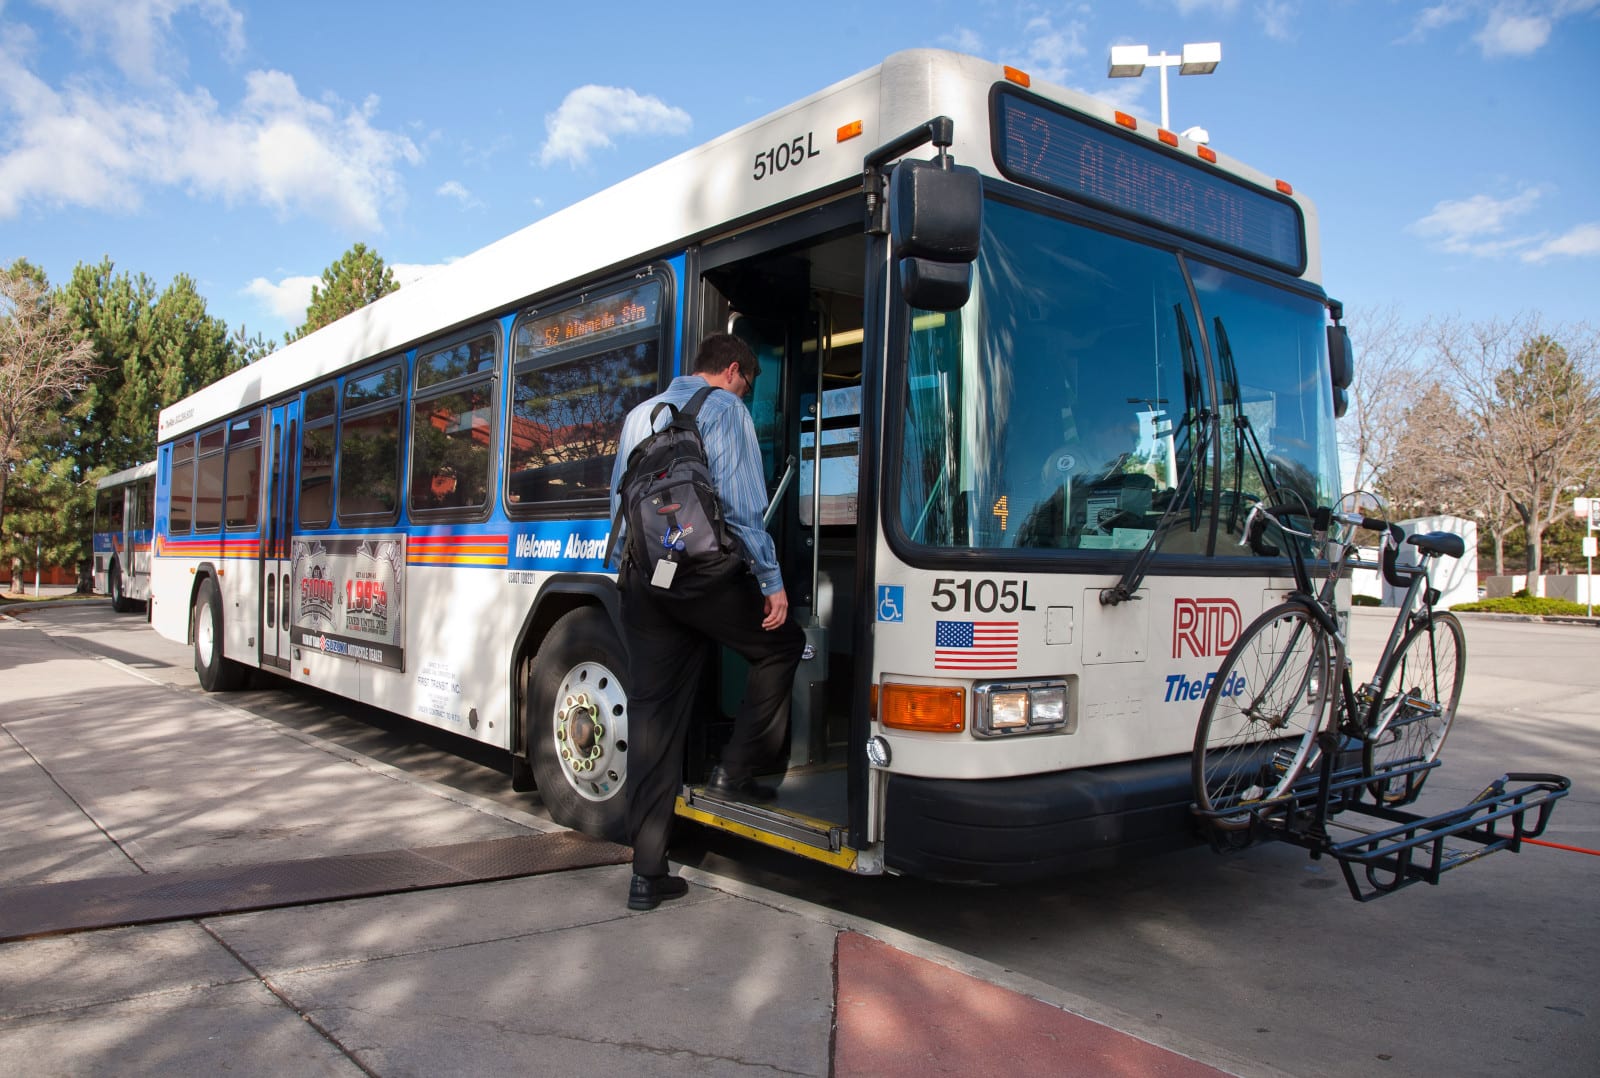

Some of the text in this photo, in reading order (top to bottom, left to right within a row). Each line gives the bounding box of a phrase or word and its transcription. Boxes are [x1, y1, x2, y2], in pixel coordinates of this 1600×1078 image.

[753, 131, 820, 181] 5105L
[1008, 107, 1245, 250] 52 ALAMEDA STN
[544, 324, 560, 346] 52
[621, 303, 646, 324] Stn
[993, 495, 1009, 531] 4
[515, 533, 610, 559] Welcome Aboard
[931, 579, 1036, 614] 5105L
[325, 638, 348, 655] SUZUKI
[1172, 598, 1242, 659] RTD
